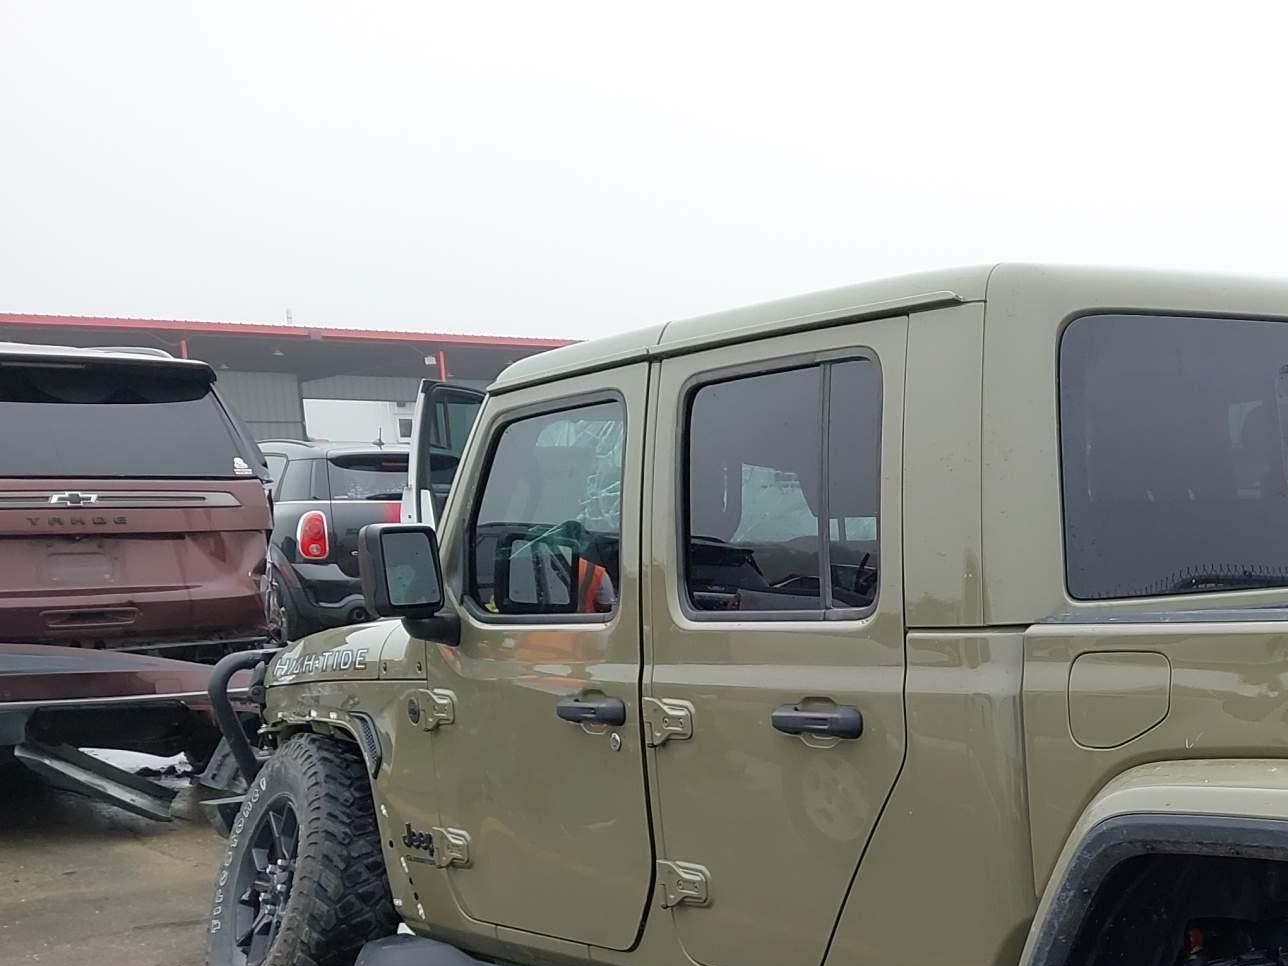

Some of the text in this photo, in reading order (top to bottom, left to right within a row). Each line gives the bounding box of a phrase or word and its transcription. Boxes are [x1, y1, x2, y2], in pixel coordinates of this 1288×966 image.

[26, 516, 128, 526] TAHOE
[321, 648, 369, 673] TIDE
[402, 823, 434, 857] Jeep
